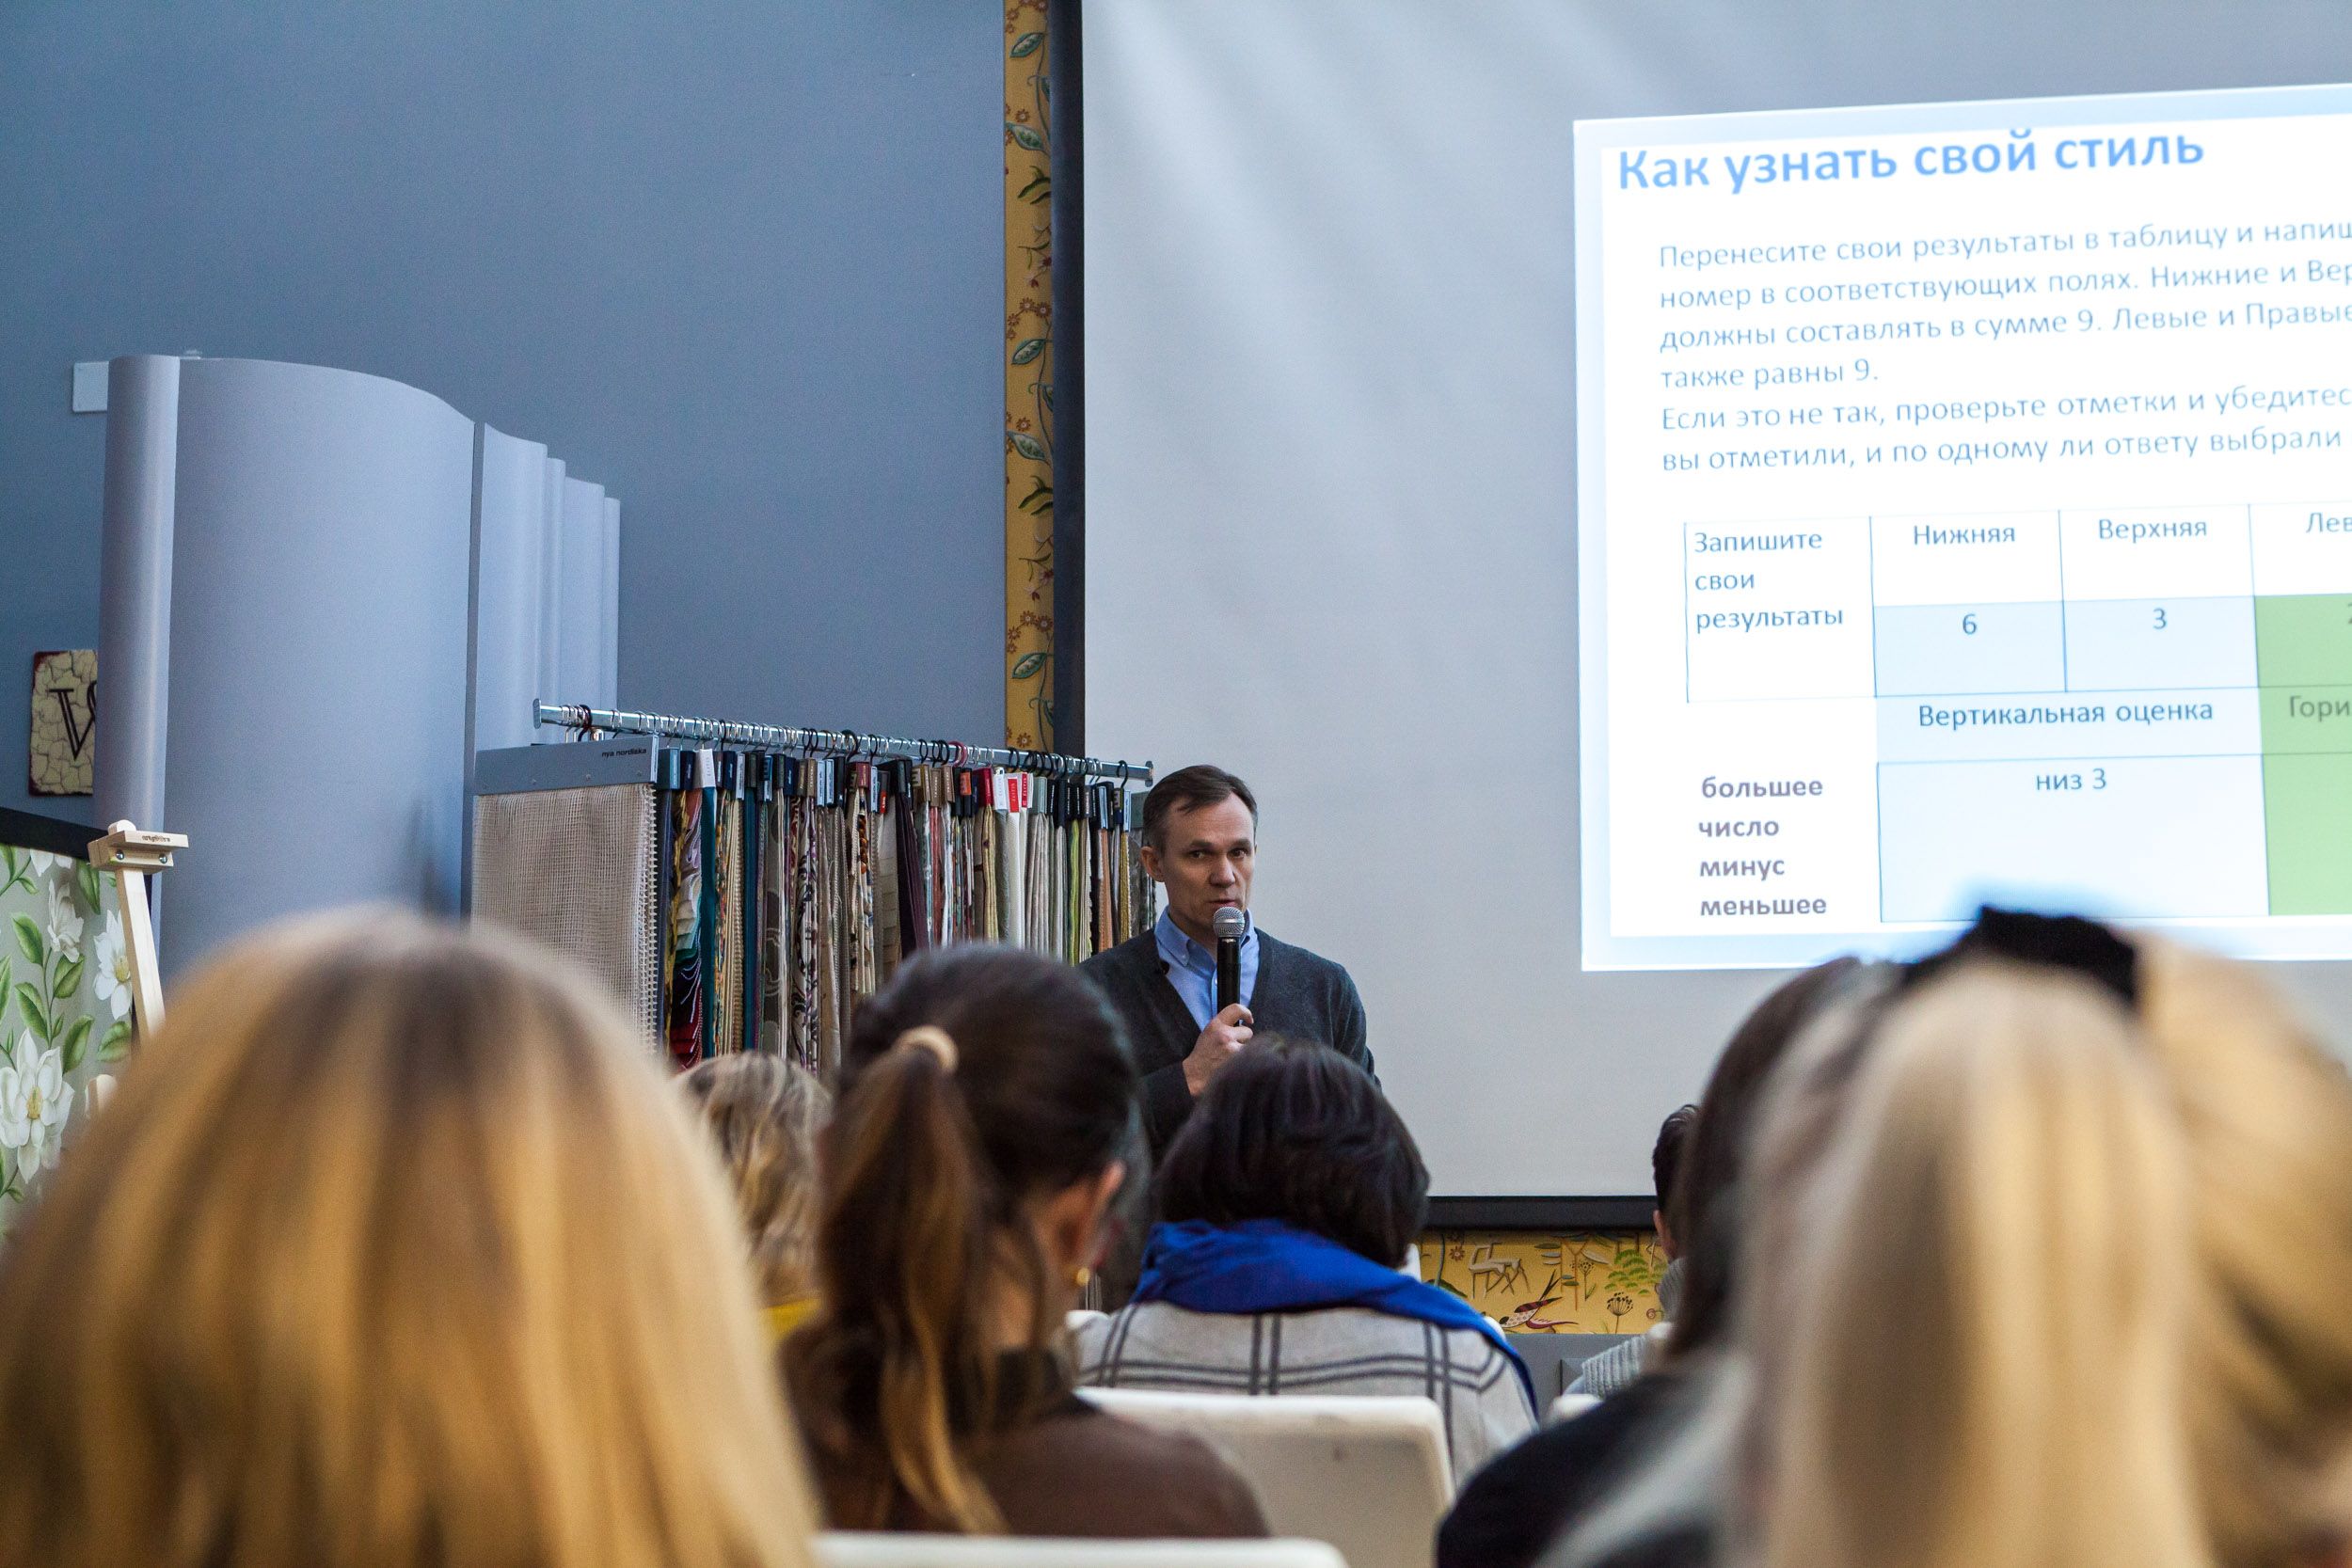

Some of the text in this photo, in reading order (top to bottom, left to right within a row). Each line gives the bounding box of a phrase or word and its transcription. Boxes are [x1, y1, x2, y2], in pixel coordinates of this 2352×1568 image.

[1619, 128, 2204, 196] Как узнать свой стиль
[1660, 244, 1827, 272] Перенесите
[1836, 241, 1901, 261] свои
[1913, 233, 2074, 263] результаты
[2084, 232, 2100, 250] в
[2108, 223, 2228, 250] таблицу
[2236, 226, 2253, 244] и
[1661, 288, 1752, 311] номер
[1761, 287, 1775, 305] в
[1785, 277, 2037, 304] соответствующих
[2048, 273, 2138, 293] полях.
[2151, 265, 2269, 288] Нижние
[2280, 265, 2296, 283] и
[1659, 327, 1775, 355] должны
[1786, 321, 1942, 343] составлять
[1950, 320, 1965, 338] в
[1974, 315, 2068, 341] сумме
[2076, 308, 2102, 332] 9.
[2112, 308, 2208, 331] Левые
[2218, 309, 2234, 326] и
[1661, 357, 1879, 391] также равны 9.
[1662, 385, 2352, 430] Если это не так, проверьте отметки и убедитес
[1662, 425, 2342, 471] вы отметили, и по одному ли ответу выбрали
[1694, 531, 1822, 553] Запишите
[1913, 525, 2016, 546] Нижняя
[2098, 518, 2207, 545] Верхняя
[1694, 574, 1755, 591] свои
[1696, 610, 1843, 635] результаты
[1962, 612, 1978, 636] 6
[2153, 607, 2169, 630] 3
[1918, 704, 2214, 732] Вертикальная оценка
[2289, 694, 2351, 723] Гори
[1701, 775, 1823, 799] большее
[2036, 767, 2107, 791] низ 3
[1698, 820, 1780, 838] число
[1699, 859, 1786, 882] минус
[1700, 898, 1827, 916] меньшее
